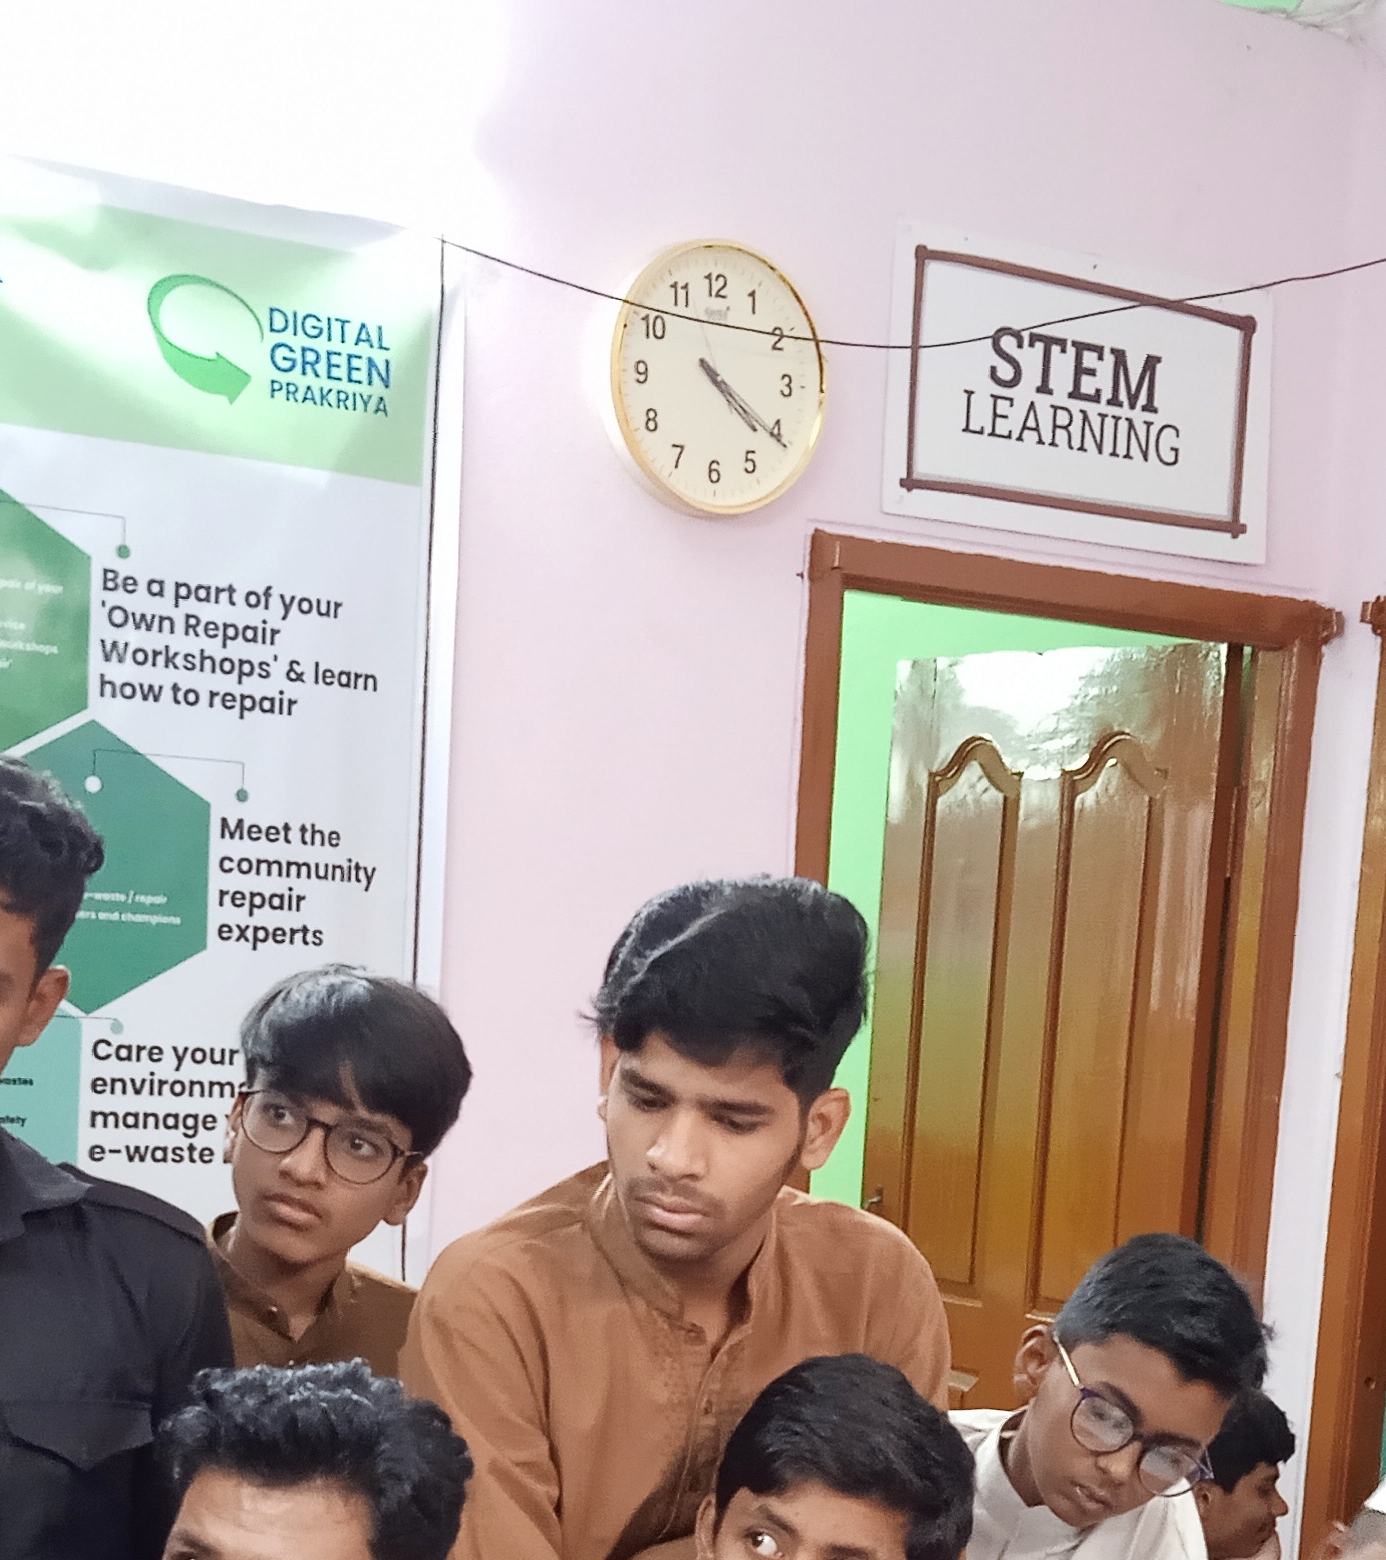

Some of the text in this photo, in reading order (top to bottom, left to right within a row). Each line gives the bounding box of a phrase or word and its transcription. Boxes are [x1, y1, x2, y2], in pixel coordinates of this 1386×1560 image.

[670, 281, 689, 307] 11
[704, 272, 728, 299] 12
[748, 290, 756, 315] 1
[268, 306, 391, 351] DIGITAL
[641, 314, 666, 339] 10
[771, 326, 785, 351] 2
[269, 341, 391, 389] GREEN
[636, 360, 648, 383] 9
[989, 326, 1163, 415] STEM
[270, 379, 389, 417] PRAKRIYA
[780, 374, 792, 398] 3
[645, 408, 658, 432] 8
[961, 388, 1182, 468] LEARNING
[671, 443, 685, 469] 7
[744, 450, 756, 474] 5
[708, 460, 721, 484] 6
[101, 567, 343, 622] Be a part of your
[101, 600, 281, 648] 'Own Repair
[100, 638, 379, 694] Workshops' & learn
[100, 672, 297, 721] how to repair
[219, 816, 341, 848] Meet the
[218, 853, 377, 892] community
[217, 887, 307, 918] repair
[121, 912, 182, 927] champions
[217, 922, 324, 951] experts
[91, 1038, 240, 1073] Care your
[89, 1108, 218, 1139] manage
[88, 1140, 215, 1164] e-waste
